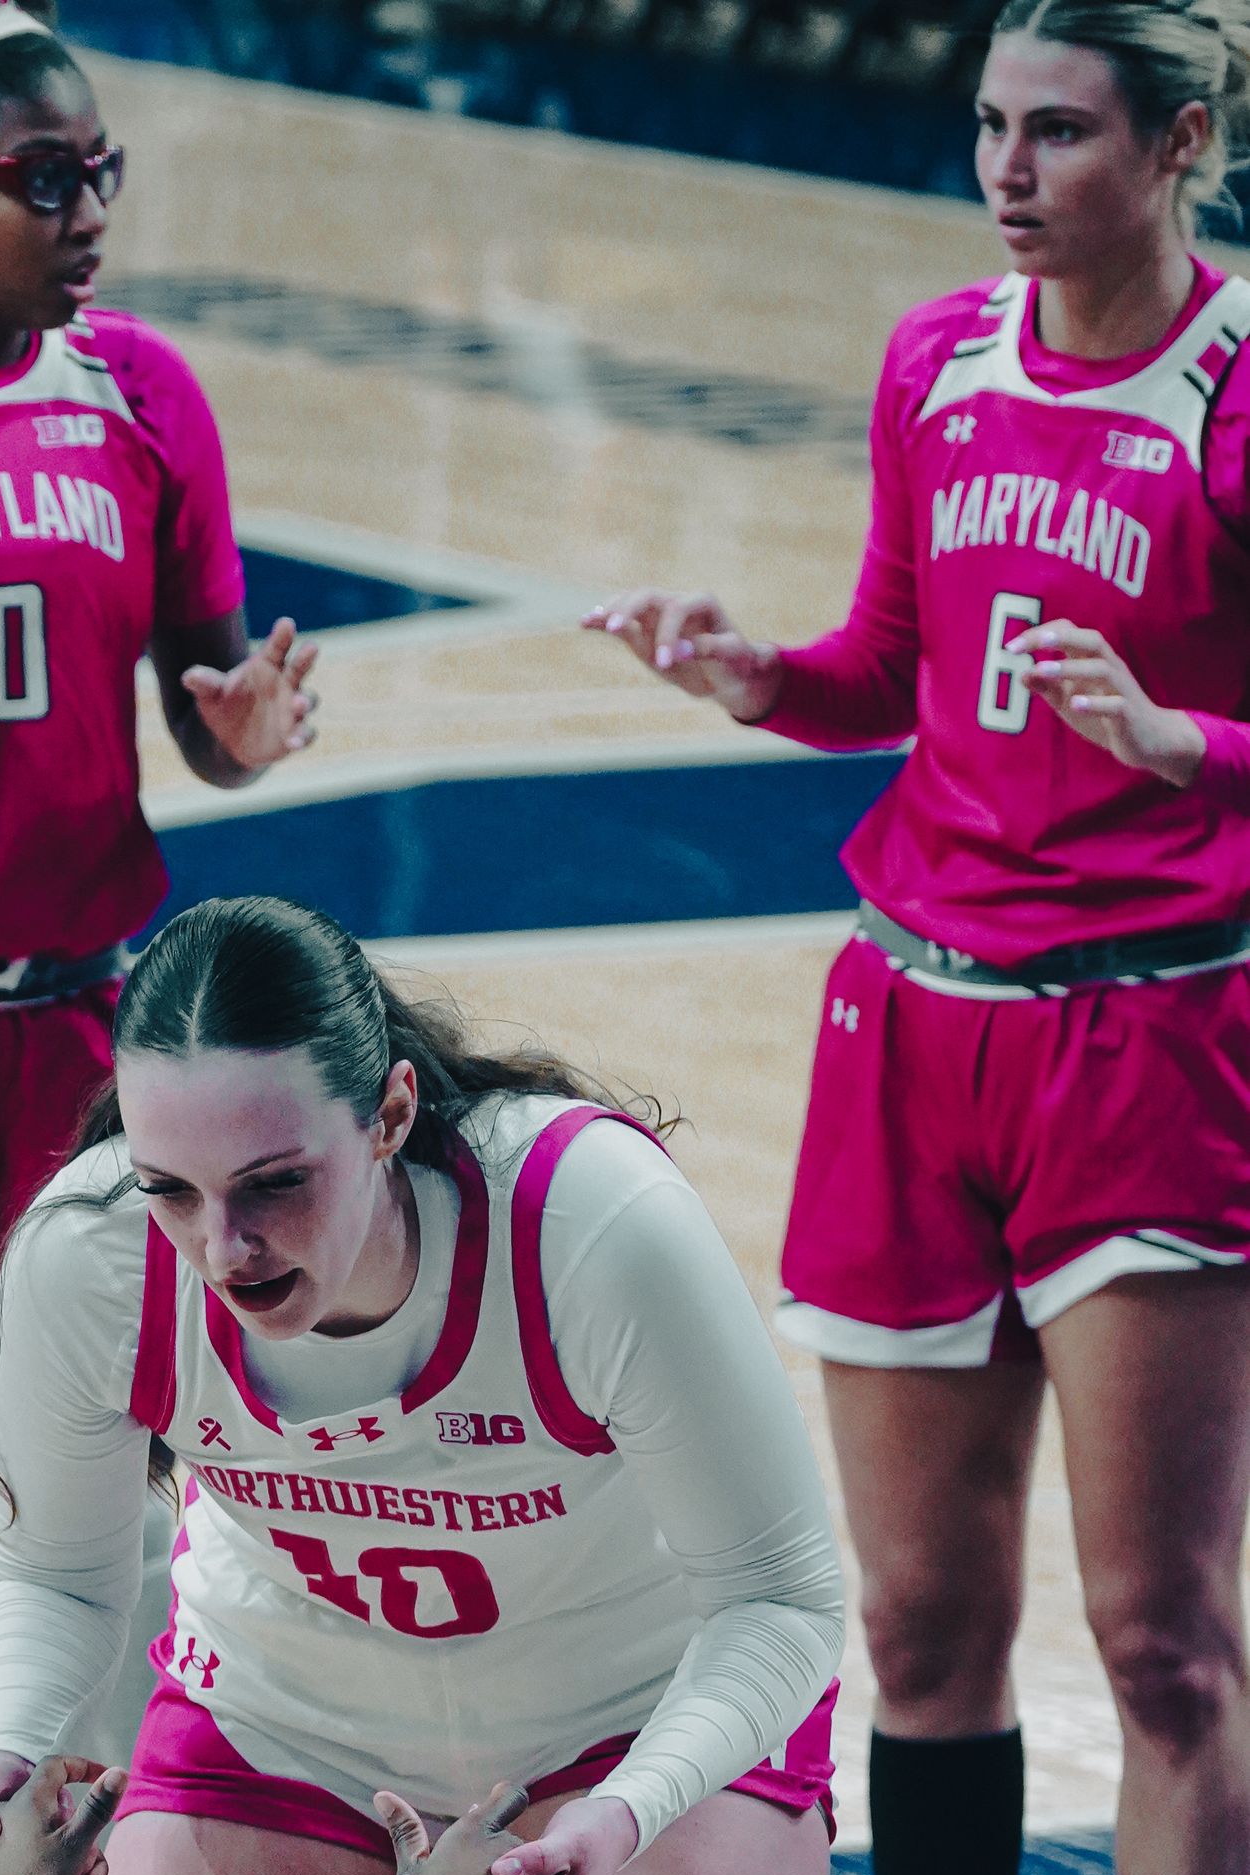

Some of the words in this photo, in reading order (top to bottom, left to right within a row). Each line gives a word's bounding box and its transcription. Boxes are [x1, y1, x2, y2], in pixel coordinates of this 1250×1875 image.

[929, 472, 1151, 598] MARYLAND
[976, 591, 1042, 736] 6
[267, 1527, 500, 1639] 10
